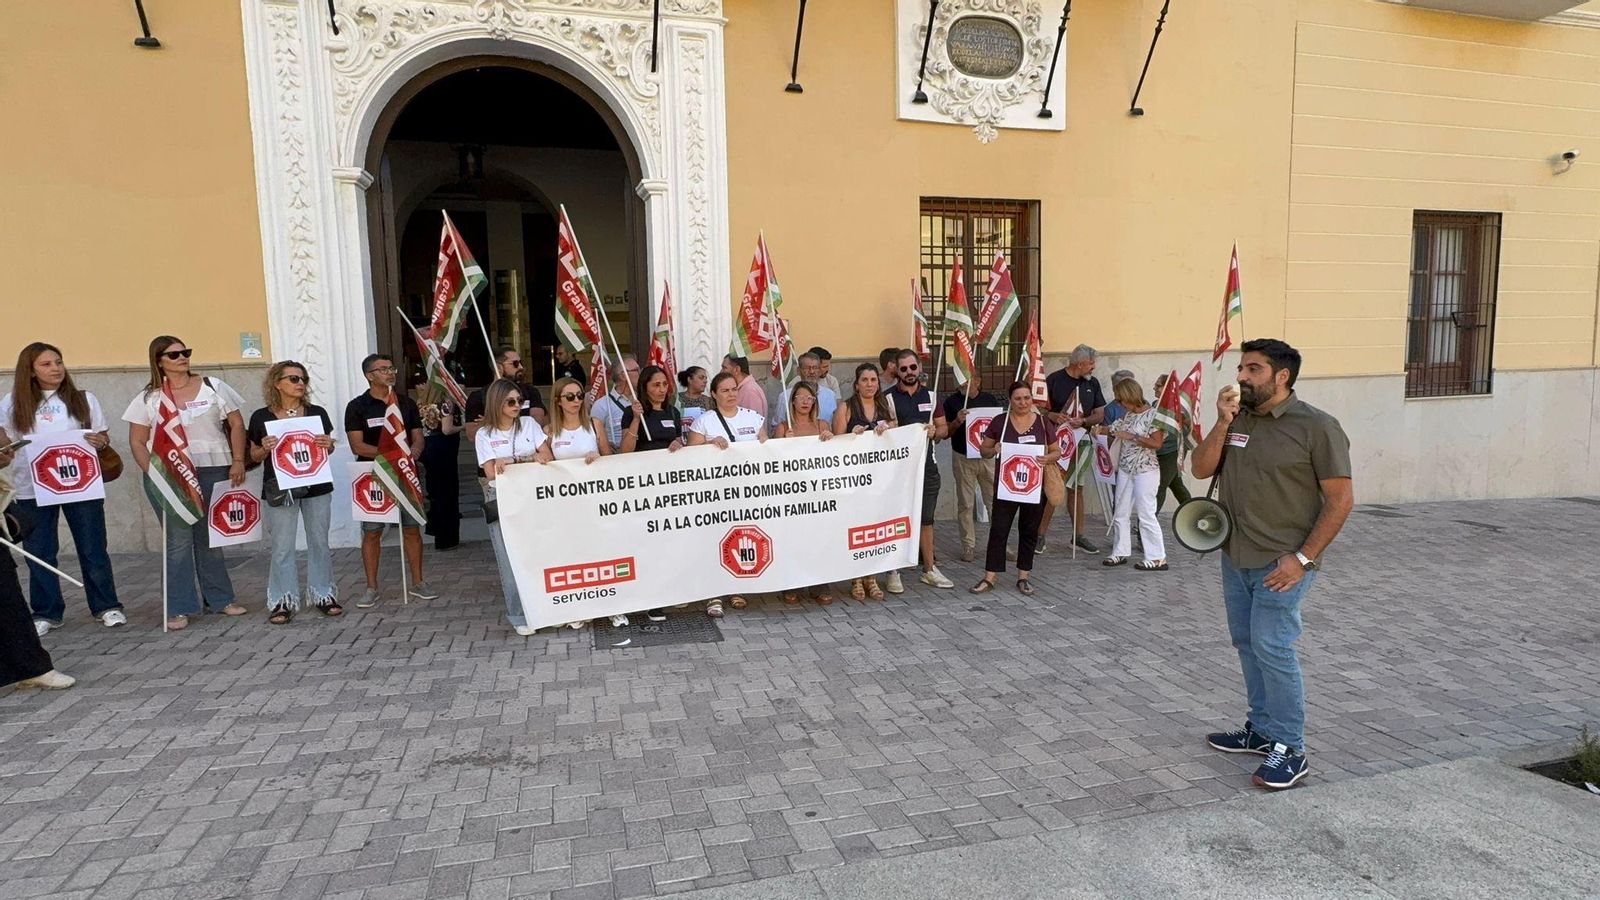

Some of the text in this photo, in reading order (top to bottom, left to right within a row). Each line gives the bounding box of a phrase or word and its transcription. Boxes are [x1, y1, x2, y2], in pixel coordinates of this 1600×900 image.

[294, 450, 309, 464] NO
[59, 465, 78, 479] NO
[536, 446, 909, 500] EN CONTRA DE LA LIBERALIZACIÓN DE HORARIOS COMERCIALES
[1016, 471, 1028, 483] NO
[370, 489, 383, 502] NO
[599, 473, 872, 517] NO A LA APERTURA EN DOMINGOS Y FESTIVOS
[230, 509, 243, 523] NO
[647, 500, 837, 533] SI A LA CONCILIACIÓN FAMILIAR
[852, 524, 895, 546] CCOO
[740, 548, 755, 562] NO
[853, 544, 897, 561] servicios
[549, 565, 615, 588] CCOO
[552, 587, 617, 605] servicios
